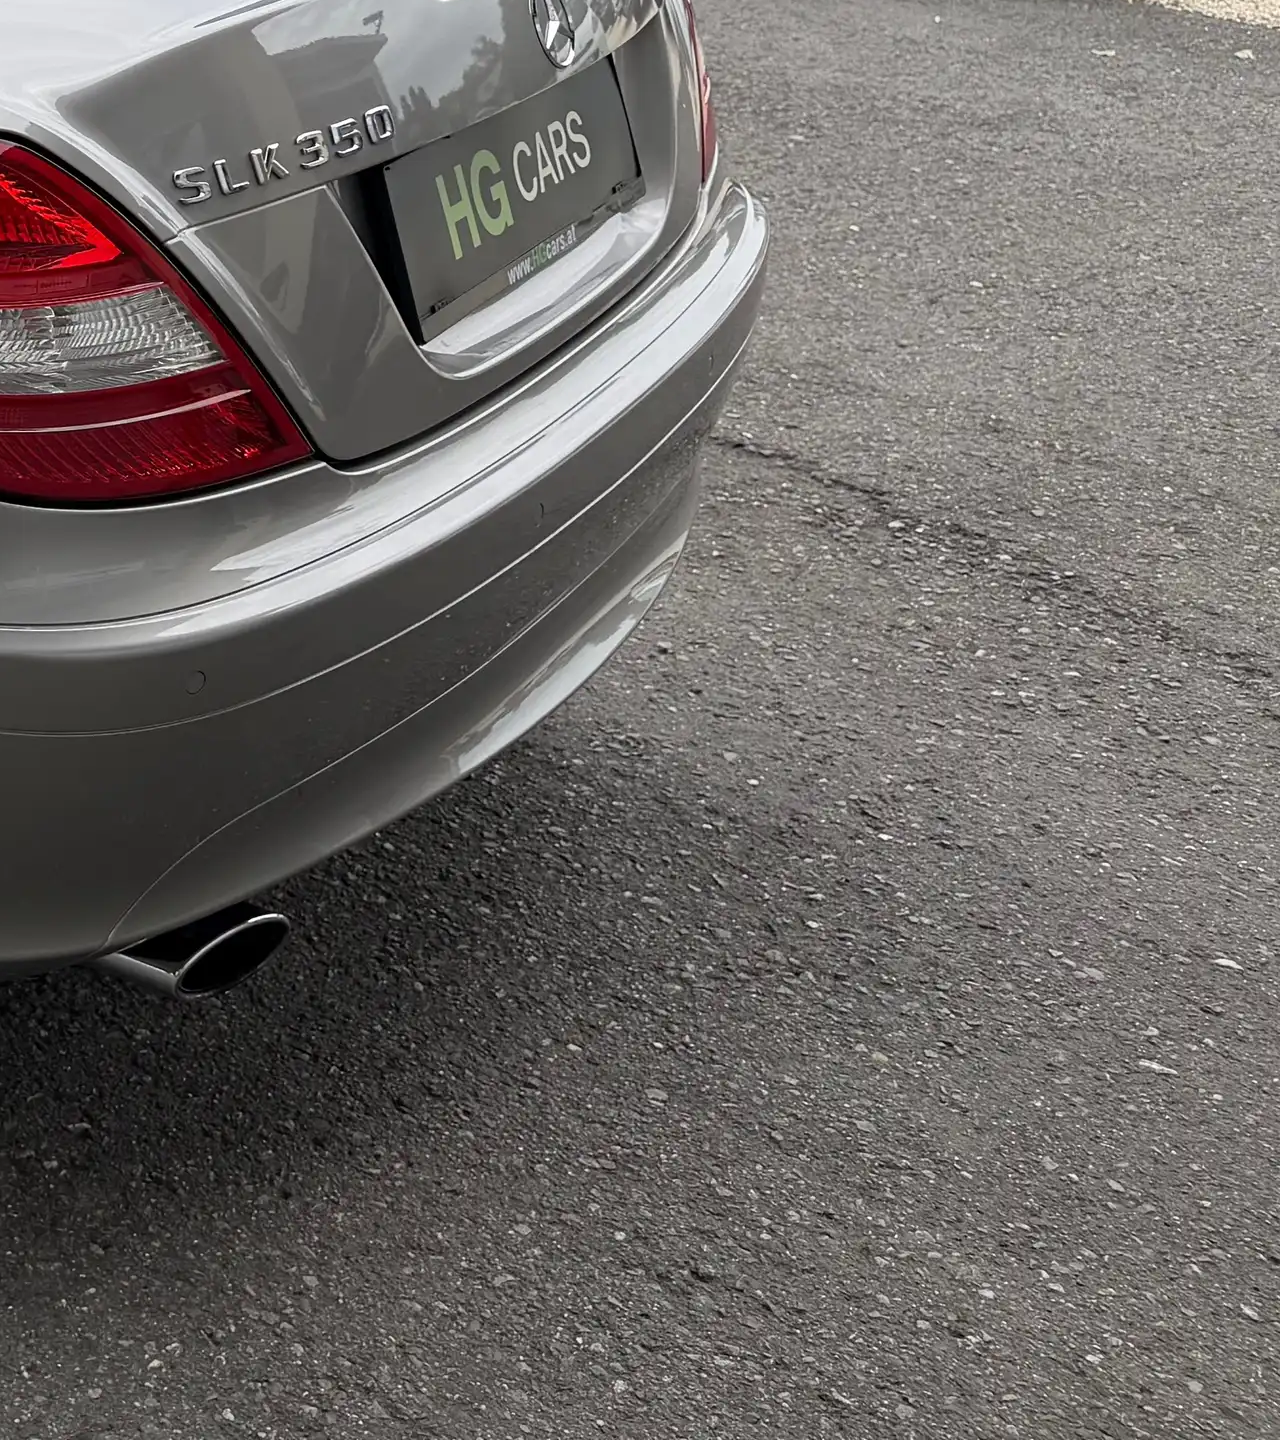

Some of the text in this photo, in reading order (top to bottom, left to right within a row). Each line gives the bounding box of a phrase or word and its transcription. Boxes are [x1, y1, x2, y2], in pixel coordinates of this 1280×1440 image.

[171, 103, 398, 206] SLK 350
[435, 109, 592, 260] HG CARS
[506, 223, 577, 285] www.HGcars.at
